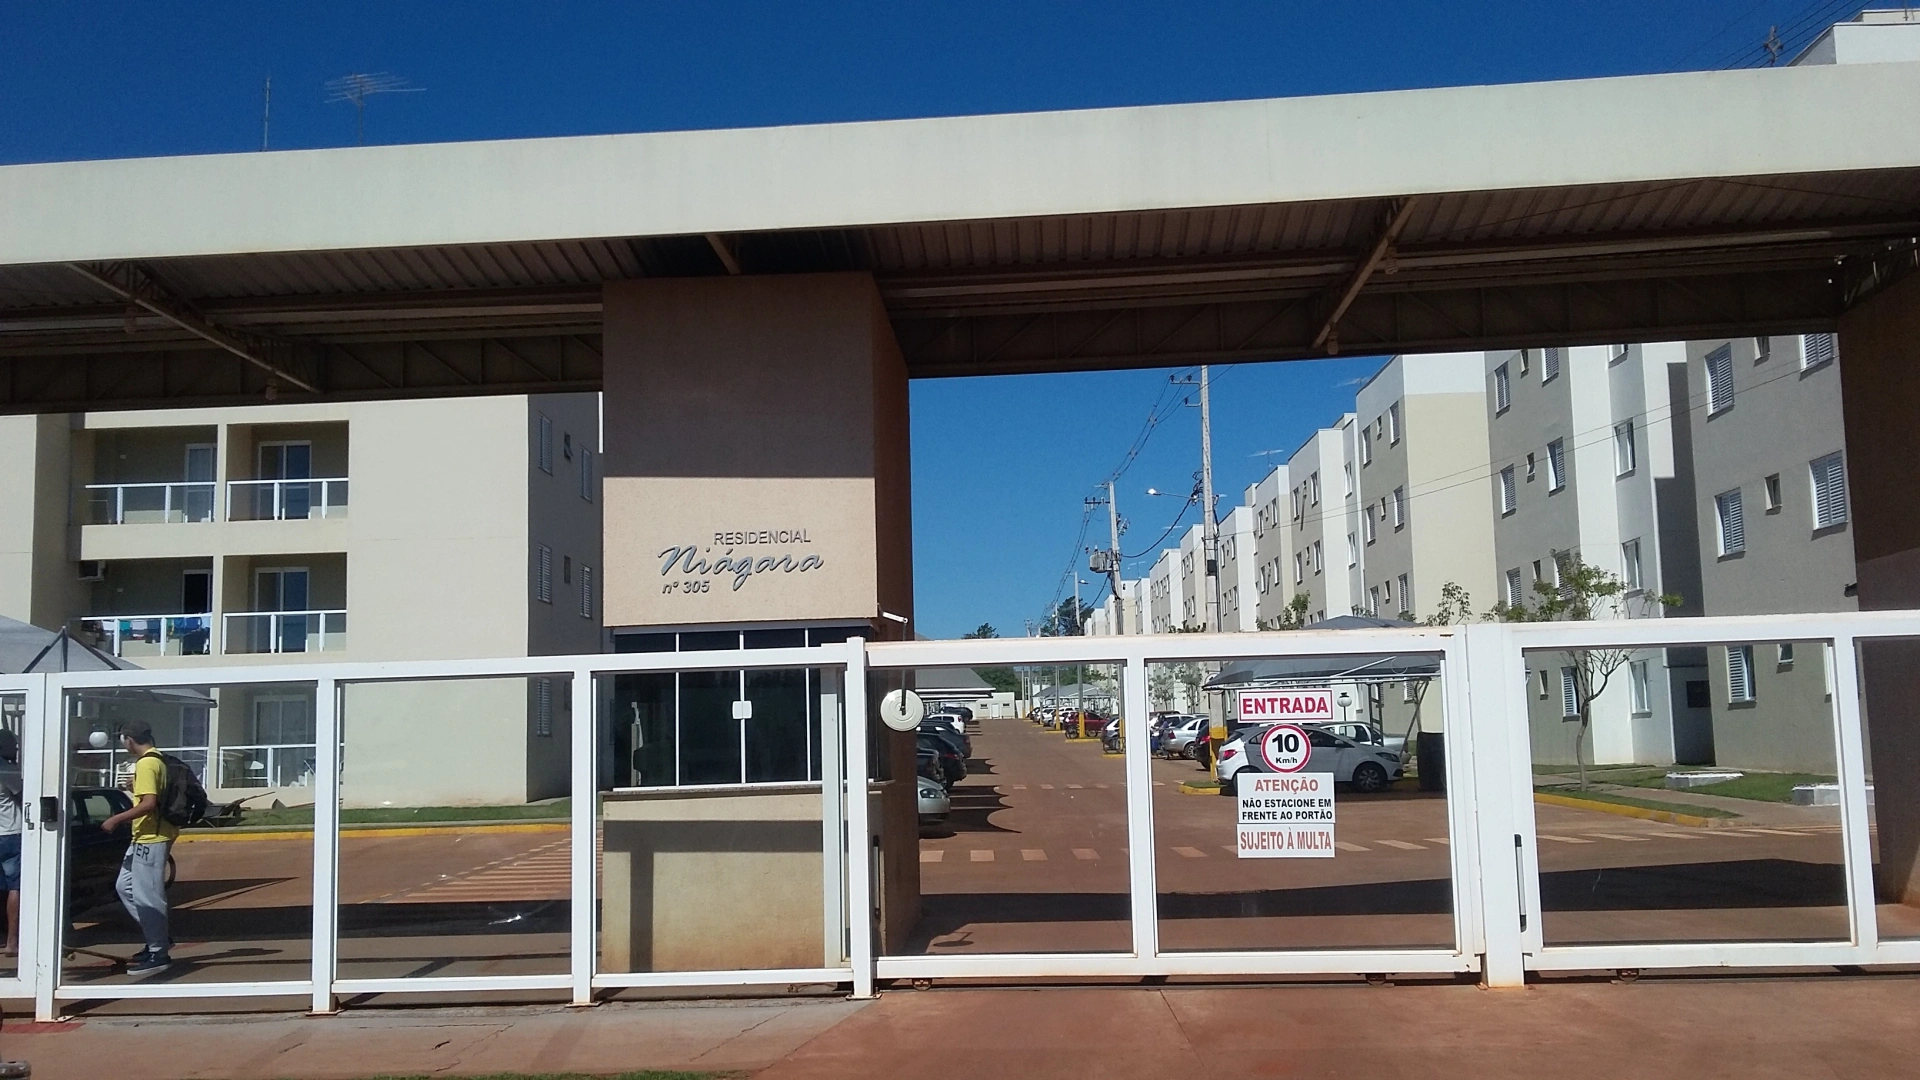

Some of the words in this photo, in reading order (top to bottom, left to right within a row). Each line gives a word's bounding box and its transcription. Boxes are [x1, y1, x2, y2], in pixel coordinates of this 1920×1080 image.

[714, 529, 811, 545] RESIDENCIAL
[682, 579, 710, 594] 305
[1242, 697, 1328, 714] ENTRADA
[1272, 733, 1299, 753] 10
[1275, 756, 1298, 764] Km/h
[1255, 777, 1319, 794] ATENÇÃO
[1242, 798, 1262, 808] NÃO
[1265, 799, 1315, 808] ESTACIONE
[1318, 799, 1332, 808] EM
[1242, 811, 1277, 820] FRENTE
[1280, 811, 1293, 820] AO
[1295, 809, 1333, 820] PORTÃO
[1240, 831, 1284, 850] SUJEITO
[1287, 826, 1294, 849] À
[1297, 831, 1332, 850] MULTA
